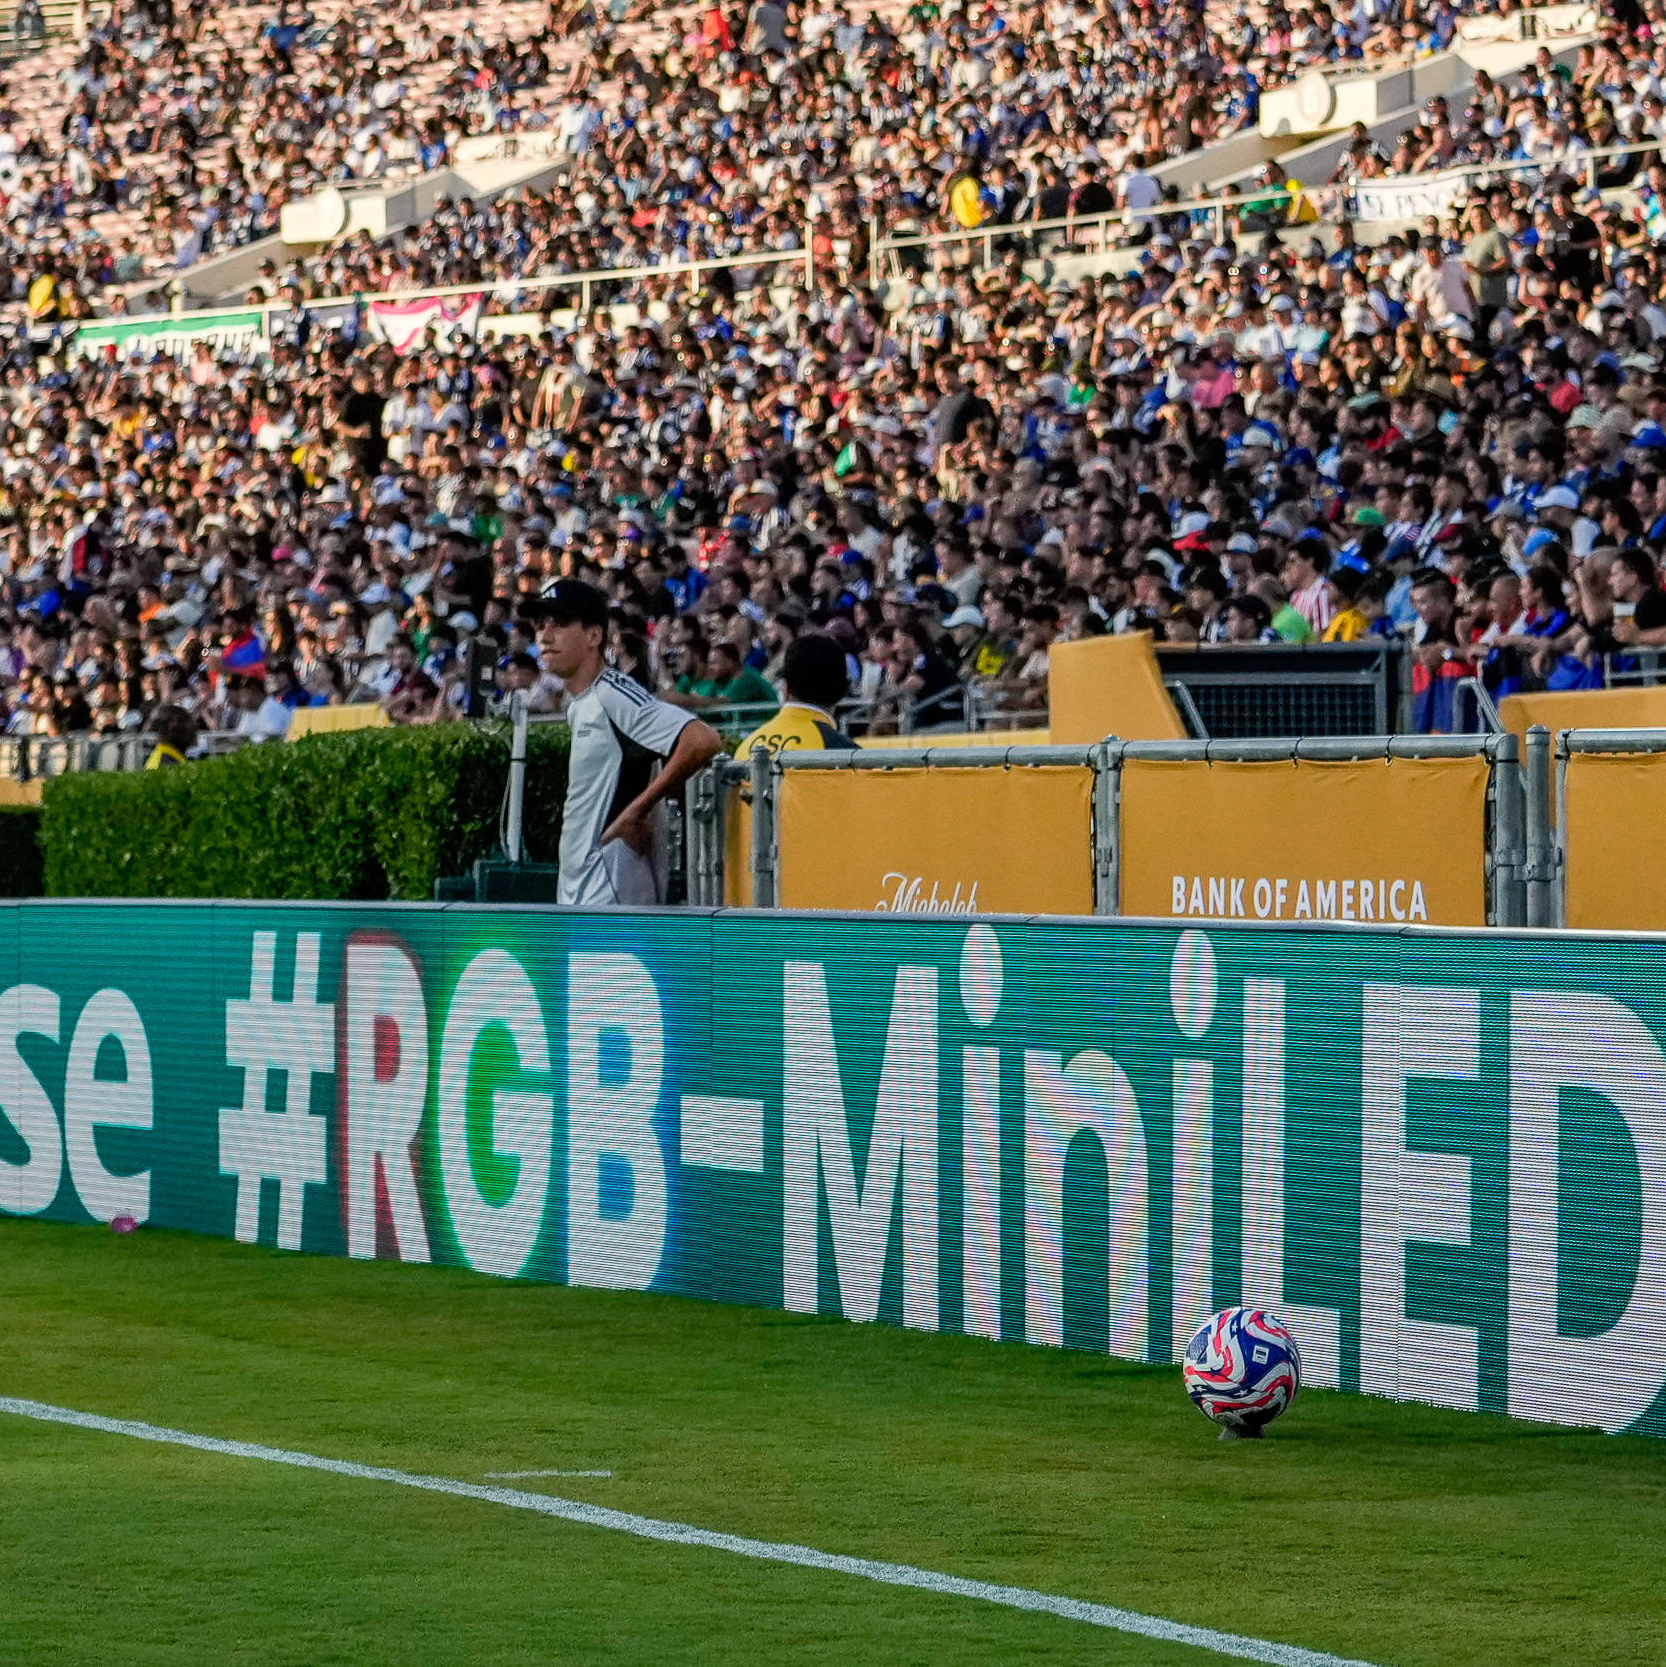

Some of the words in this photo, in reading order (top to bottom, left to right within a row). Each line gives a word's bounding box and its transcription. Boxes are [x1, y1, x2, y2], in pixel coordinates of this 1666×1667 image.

[1171, 875, 1246, 917] BANK
[1253, 877, 1289, 919] OF
[1294, 879, 1429, 922] AMERICA
